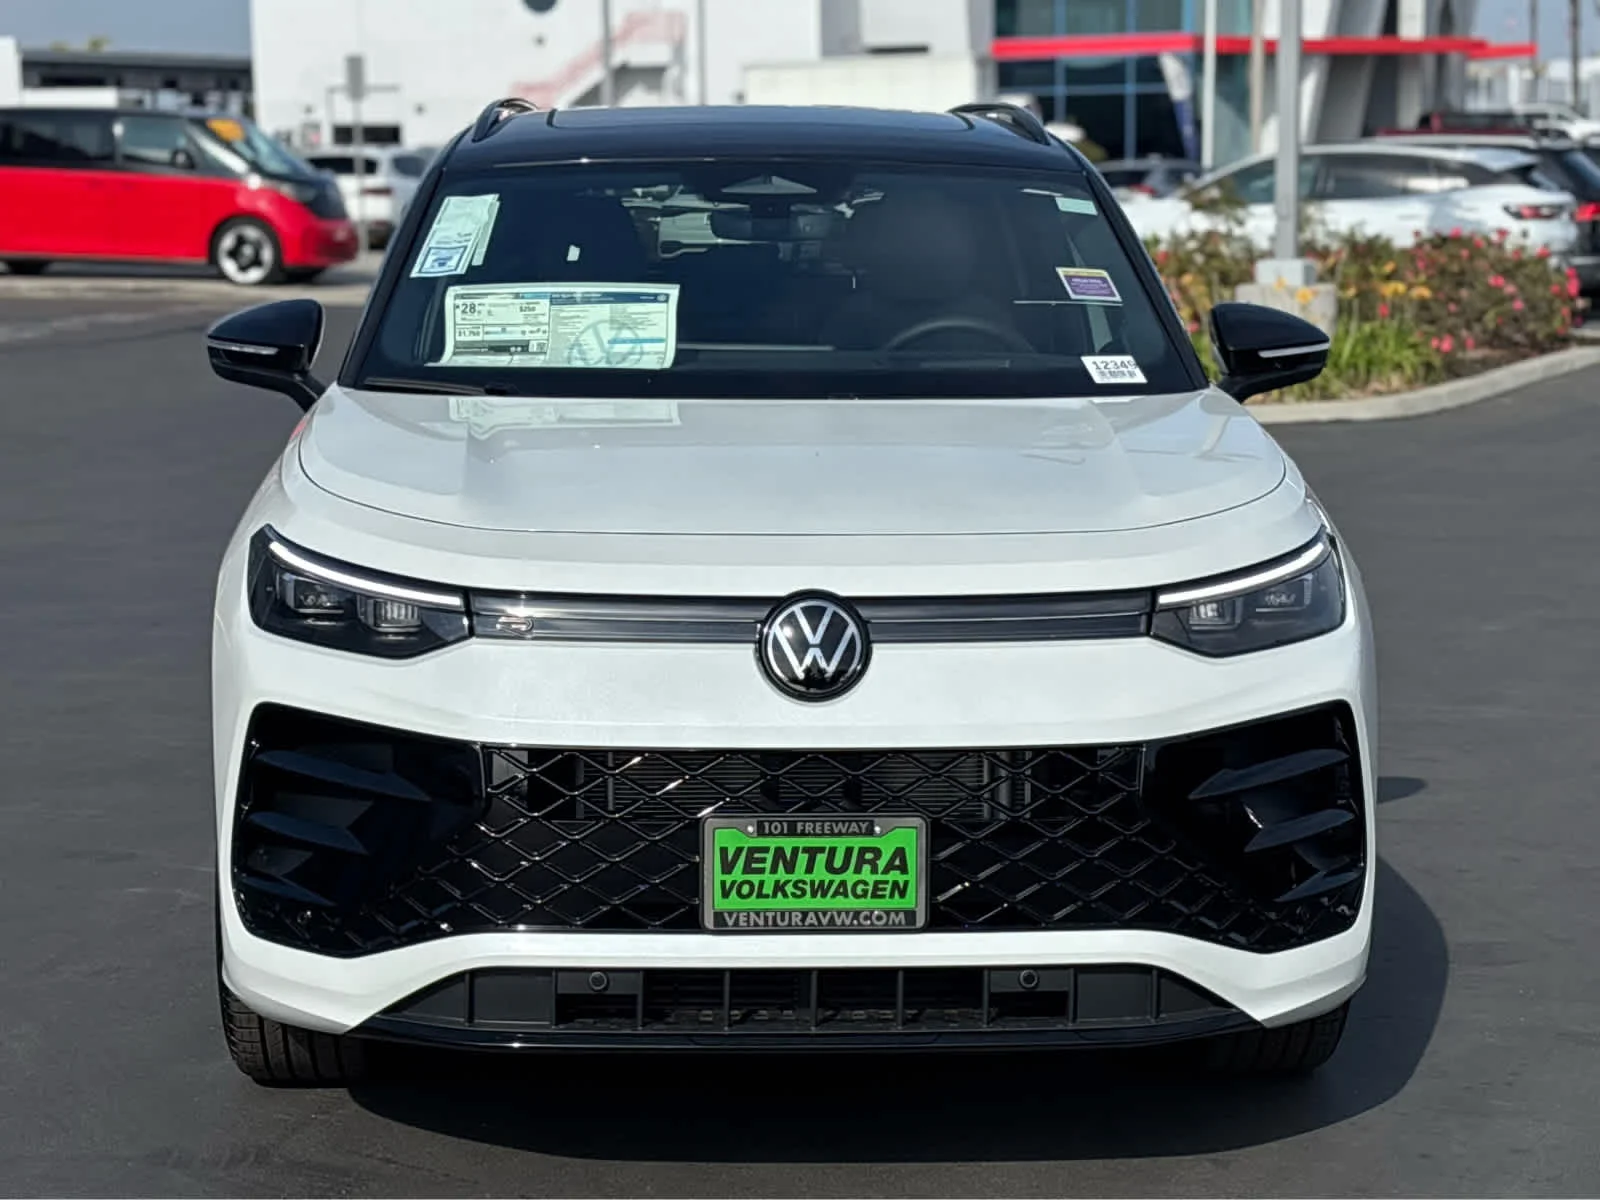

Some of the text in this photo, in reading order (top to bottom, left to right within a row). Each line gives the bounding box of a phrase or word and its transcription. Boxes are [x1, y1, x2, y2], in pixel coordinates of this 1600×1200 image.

[461, 302, 477, 314] 28
[763, 821, 870, 834] 101 FREEWAY
[718, 846, 909, 875] VENTURA
[719, 879, 909, 900] VOLKSWAGEN
[723, 911, 906, 927] VENTURAVW.COM
